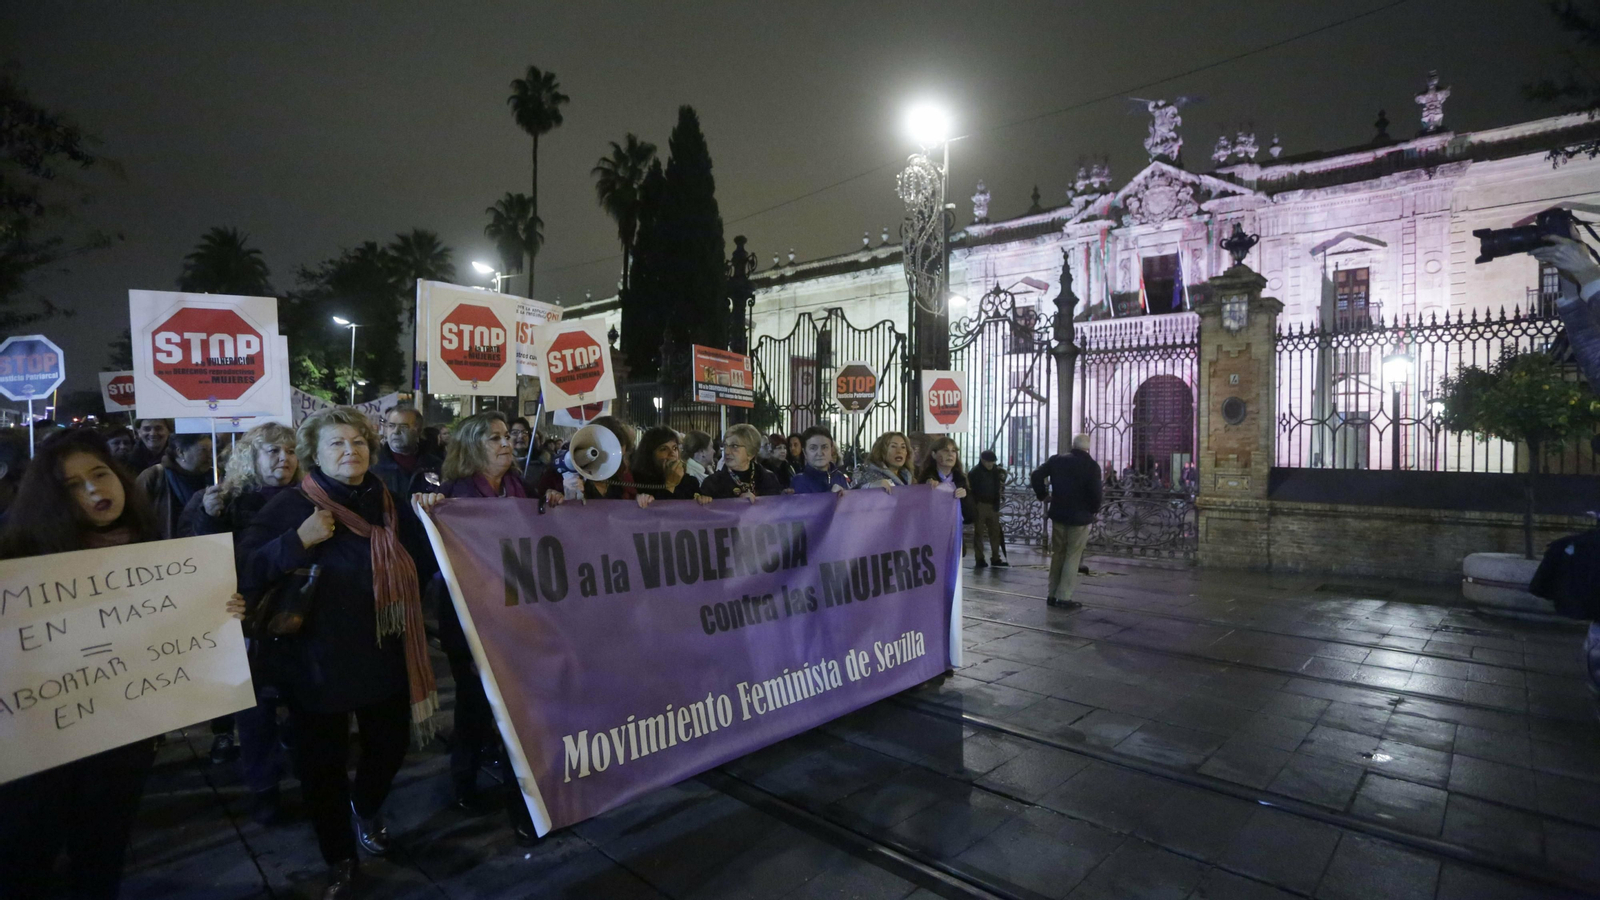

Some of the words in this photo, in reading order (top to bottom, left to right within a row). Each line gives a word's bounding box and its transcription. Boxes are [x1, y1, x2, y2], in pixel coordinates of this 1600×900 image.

[155, 331, 260, 364] STOP
[443, 322, 505, 351] STOP
[0, 352, 58, 376] STOP
[469, 352, 501, 362] MUJERES
[548, 345, 601, 374] STOP
[25, 372, 58, 381] Patriarcal
[108, 382, 135, 395] STO
[212, 376, 255, 384] MUJERES
[838, 376, 875, 393] STOP
[930, 390, 961, 407] STOP
[503, 535, 569, 607] NO
[578, 563, 598, 598] a
[603, 554, 631, 595] la
[633, 521, 809, 590] VIOLENCIA
[2, 557, 198, 616] MINICIDIOS
[700, 590, 779, 635] contra
[782, 585, 819, 618] las
[819, 544, 936, 608] MUJERES
[18, 618, 67, 652] EN
[98, 595, 178, 629] MASA
[147, 631, 217, 662] SOLAS
[54, 698, 95, 730] EN
[124, 667, 191, 701] CASA
[562, 691, 733, 784] Movimiento
[736, 657, 843, 721] Feminista
[845, 648, 871, 682] de
[876, 629, 926, 670] Sevilla
